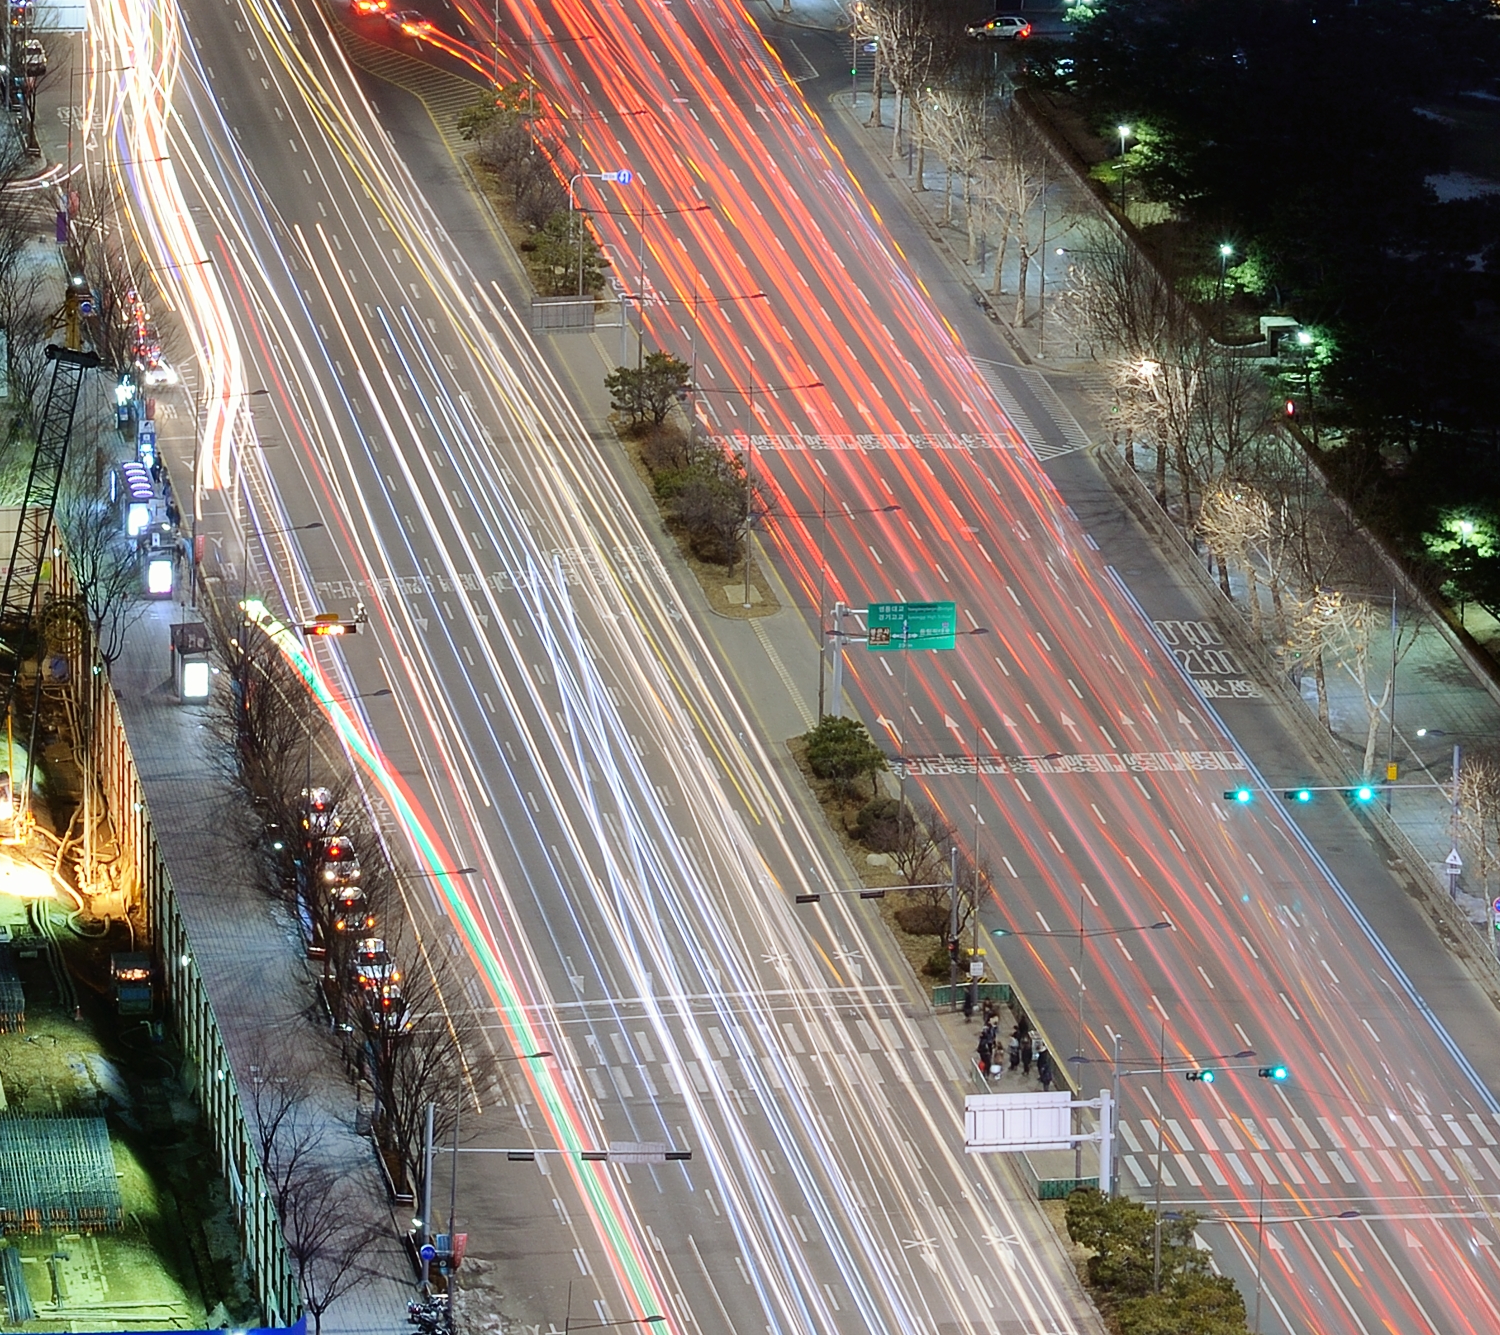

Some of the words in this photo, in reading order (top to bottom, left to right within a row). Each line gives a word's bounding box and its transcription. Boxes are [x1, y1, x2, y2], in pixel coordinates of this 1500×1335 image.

[1153, 620, 1224, 646] 07:00
[1174, 649, 1245, 675] 21:00
[1194, 679, 1263, 699] 버스전용
[1066, 753, 1126, 773] 영동대교
[1124, 752, 1186, 773] 영동대교
[1184, 750, 1246, 771] 영동대교
